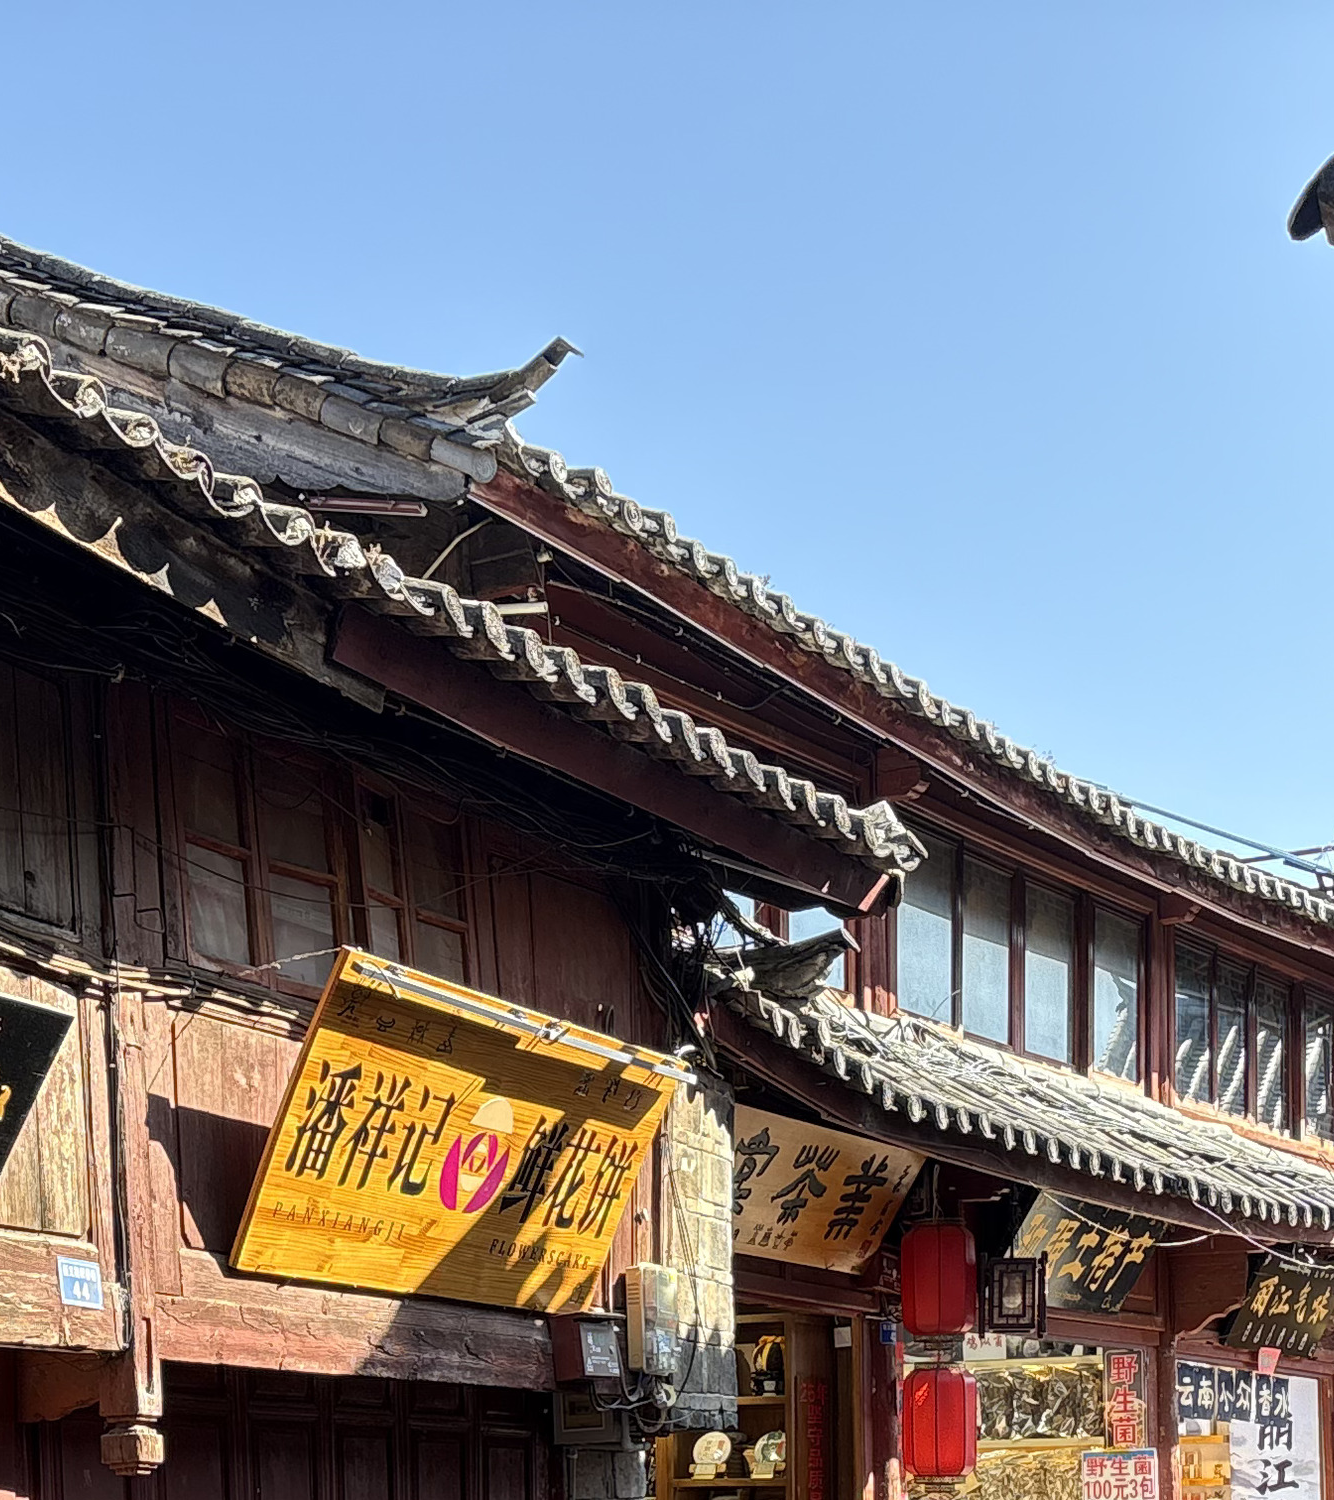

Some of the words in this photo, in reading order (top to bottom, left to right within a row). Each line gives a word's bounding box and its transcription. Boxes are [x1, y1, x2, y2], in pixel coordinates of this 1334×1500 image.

[285, 1060, 455, 1196] 潘祥记
[499, 1115, 638, 1239] 鲜花饼
[272, 1202, 406, 1241] PANXIANGJI
[1109, 1354, 1138, 1446] 野生菌
[1175, 1375, 1289, 1418] 云南小众香水
[1086, 1456, 1153, 1477] 野生菌
[1084, 1475, 1155, 1500] 100元3包
